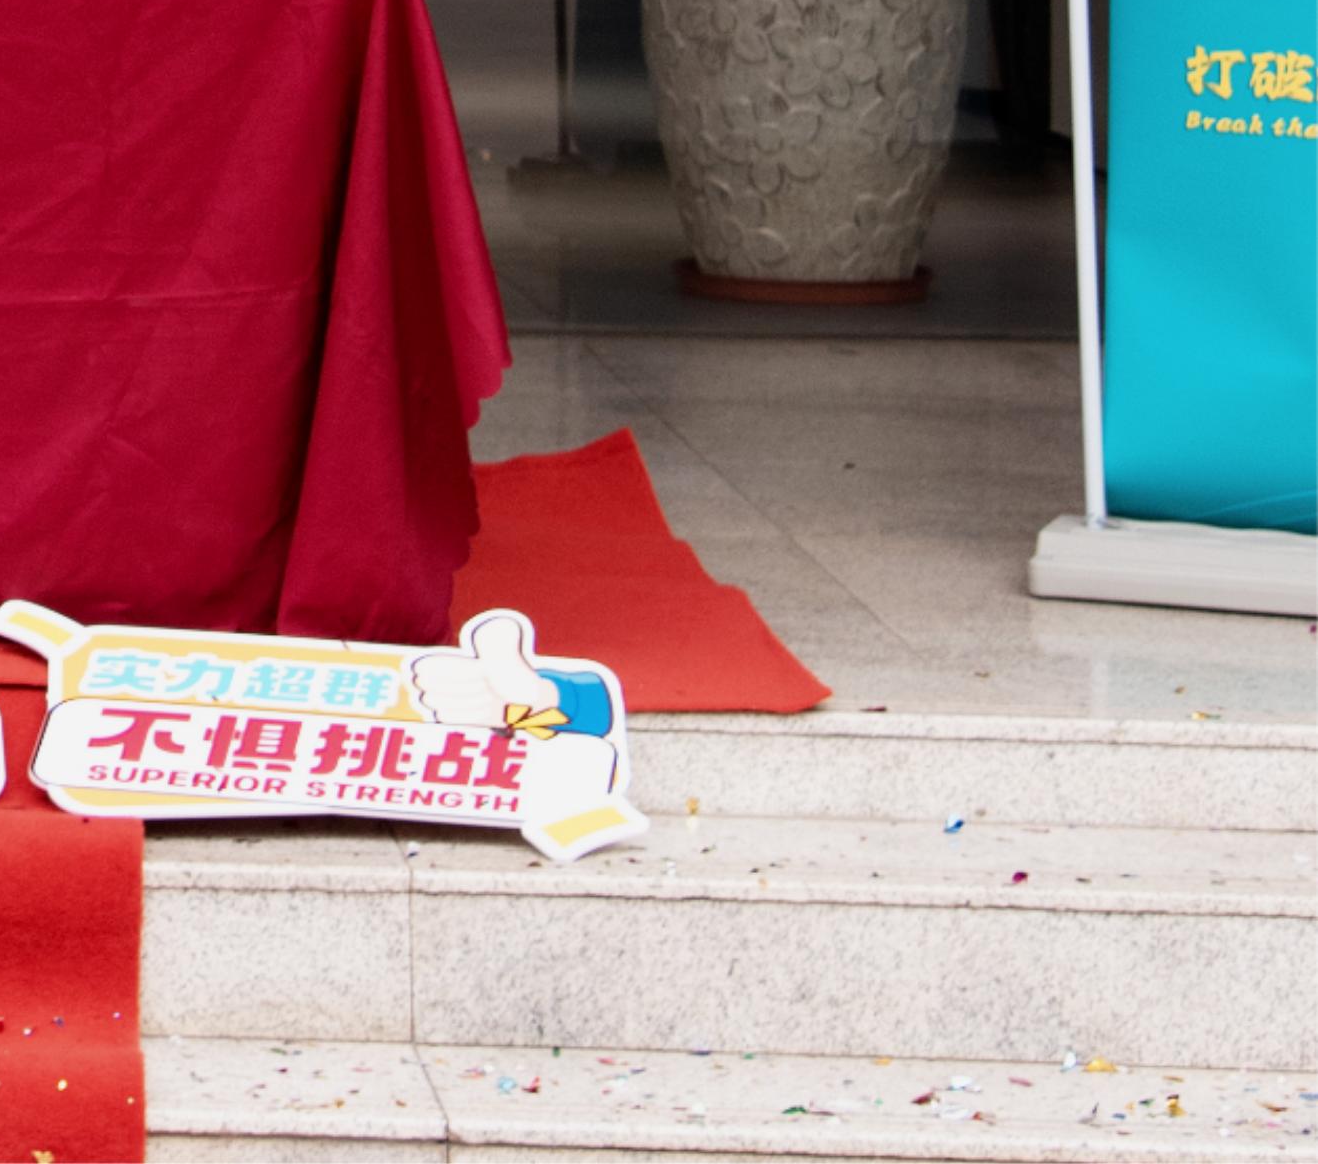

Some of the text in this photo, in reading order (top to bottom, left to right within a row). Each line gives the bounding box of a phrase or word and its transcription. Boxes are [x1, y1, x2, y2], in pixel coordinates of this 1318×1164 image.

[1185, 109, 1263, 136] Break
[78, 651, 392, 709] 实力超群
[87, 708, 528, 790] 不惧挑战
[88, 764, 519, 812] SUPERIOR STRENGTH
